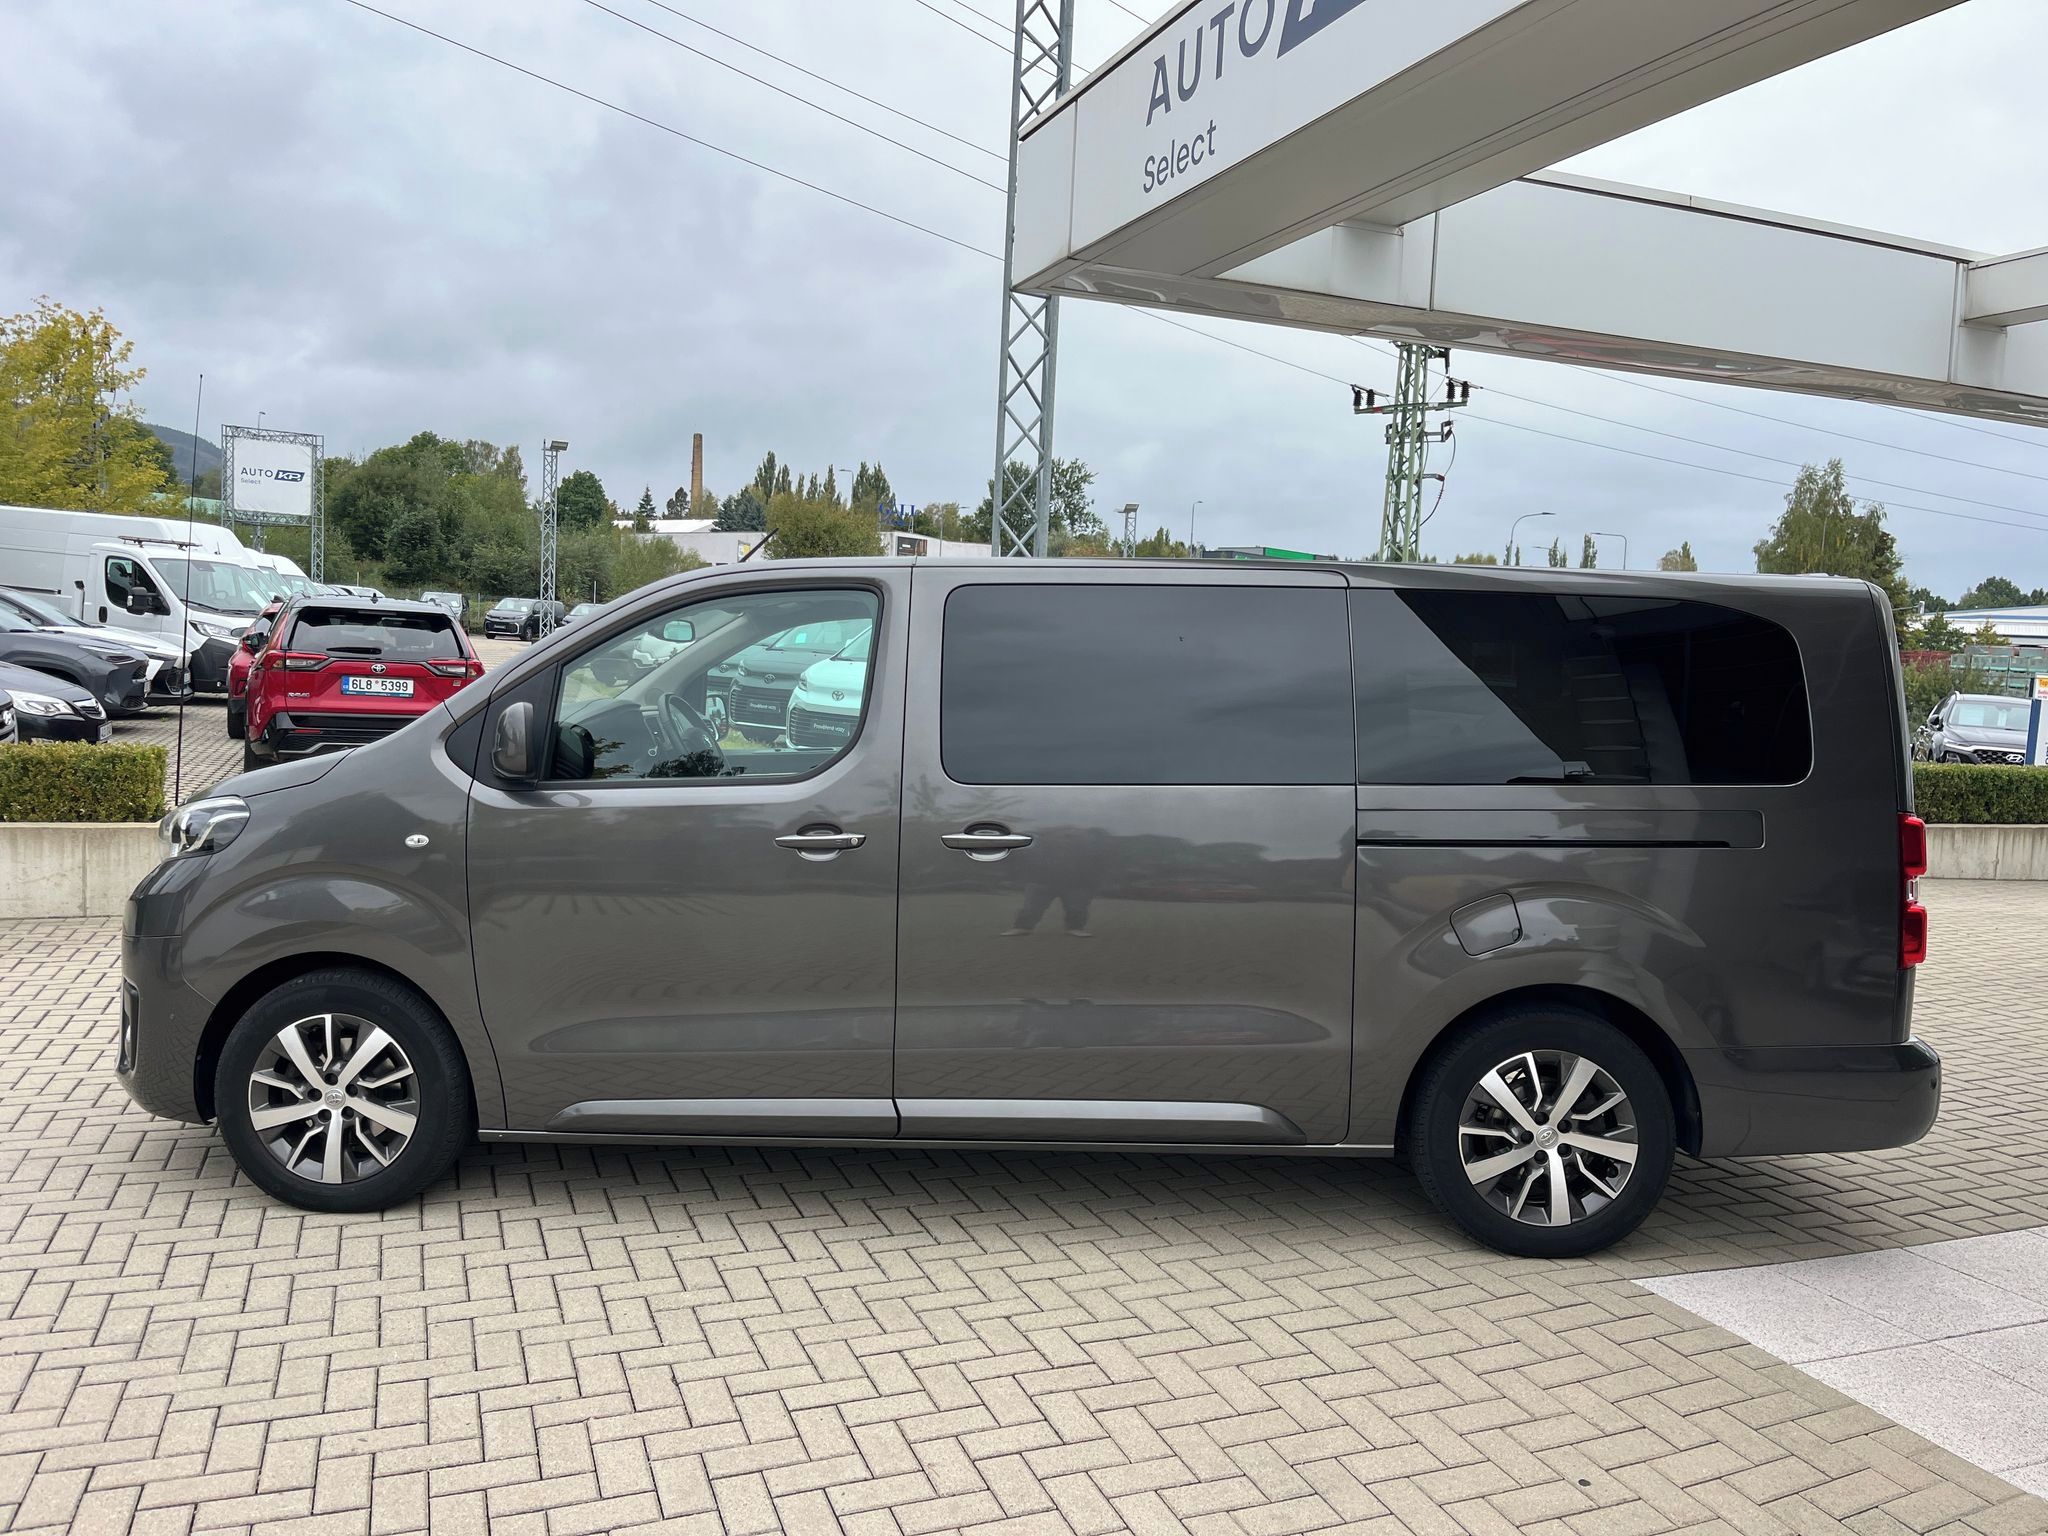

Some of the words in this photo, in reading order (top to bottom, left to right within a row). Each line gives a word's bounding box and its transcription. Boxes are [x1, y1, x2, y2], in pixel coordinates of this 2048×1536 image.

[1146, 0, 1275, 127] AUTO
[1143, 119, 1217, 194] Select
[240, 467, 273, 478] AUTO
[351, 679, 373, 690] 6L8
[381, 680, 408, 691] 5399
